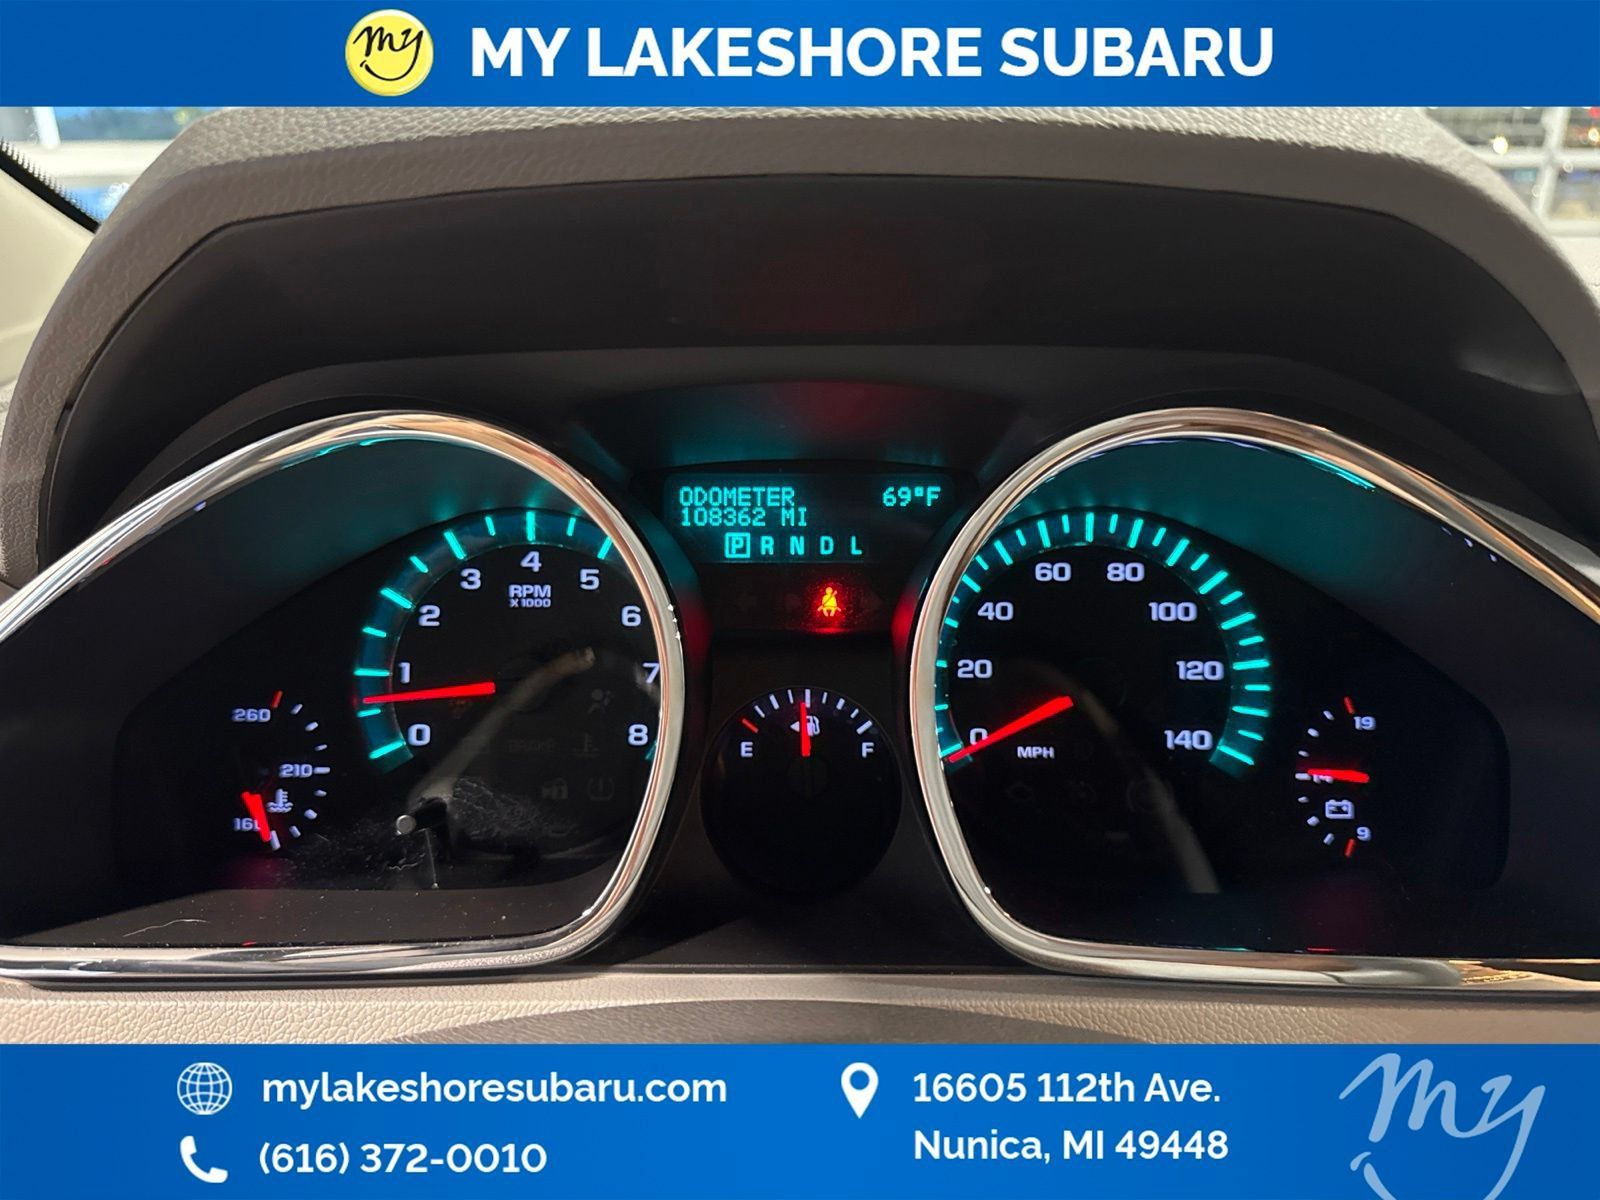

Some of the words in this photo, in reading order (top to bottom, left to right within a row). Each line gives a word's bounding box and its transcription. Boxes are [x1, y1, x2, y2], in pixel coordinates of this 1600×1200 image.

[679, 486, 795, 506] ODOMETER
[882, 486, 941, 507] 69°F
[681, 507, 766, 527] 108362
[781, 507, 808, 527] MI
[731, 536, 745, 554] P
[760, 535, 775, 555] R
[789, 535, 805, 555] N
[819, 535, 835, 555] D
[850, 535, 863, 555] L
[520, 551, 542, 573] 4
[1034, 562, 1072, 582] 60
[1106, 562, 1145, 582] 80
[460, 568, 482, 590] 3
[580, 568, 600, 590] 5
[509, 584, 552, 598] RPM
[418, 604, 441, 627] 2
[621, 604, 642, 627] 6
[977, 601, 1014, 621] 40
[1148, 601, 1197, 622] 100
[399, 662, 411, 684] 1
[642, 662, 660, 684] 7
[957, 659, 993, 679] 20
[1175, 660, 1224, 681] 120
[232, 708, 271, 723] 260
[1353, 716, 1376, 731] 19
[406, 723, 431, 746] 0
[628, 723, 649, 746] 8
[1163, 729, 1213, 750] 140
[740, 741, 754, 758] E
[861, 741, 875, 758] F
[1016, 745, 1055, 760] MPH
[279, 763, 313, 778] 210
[1356, 826, 1372, 842] 9
